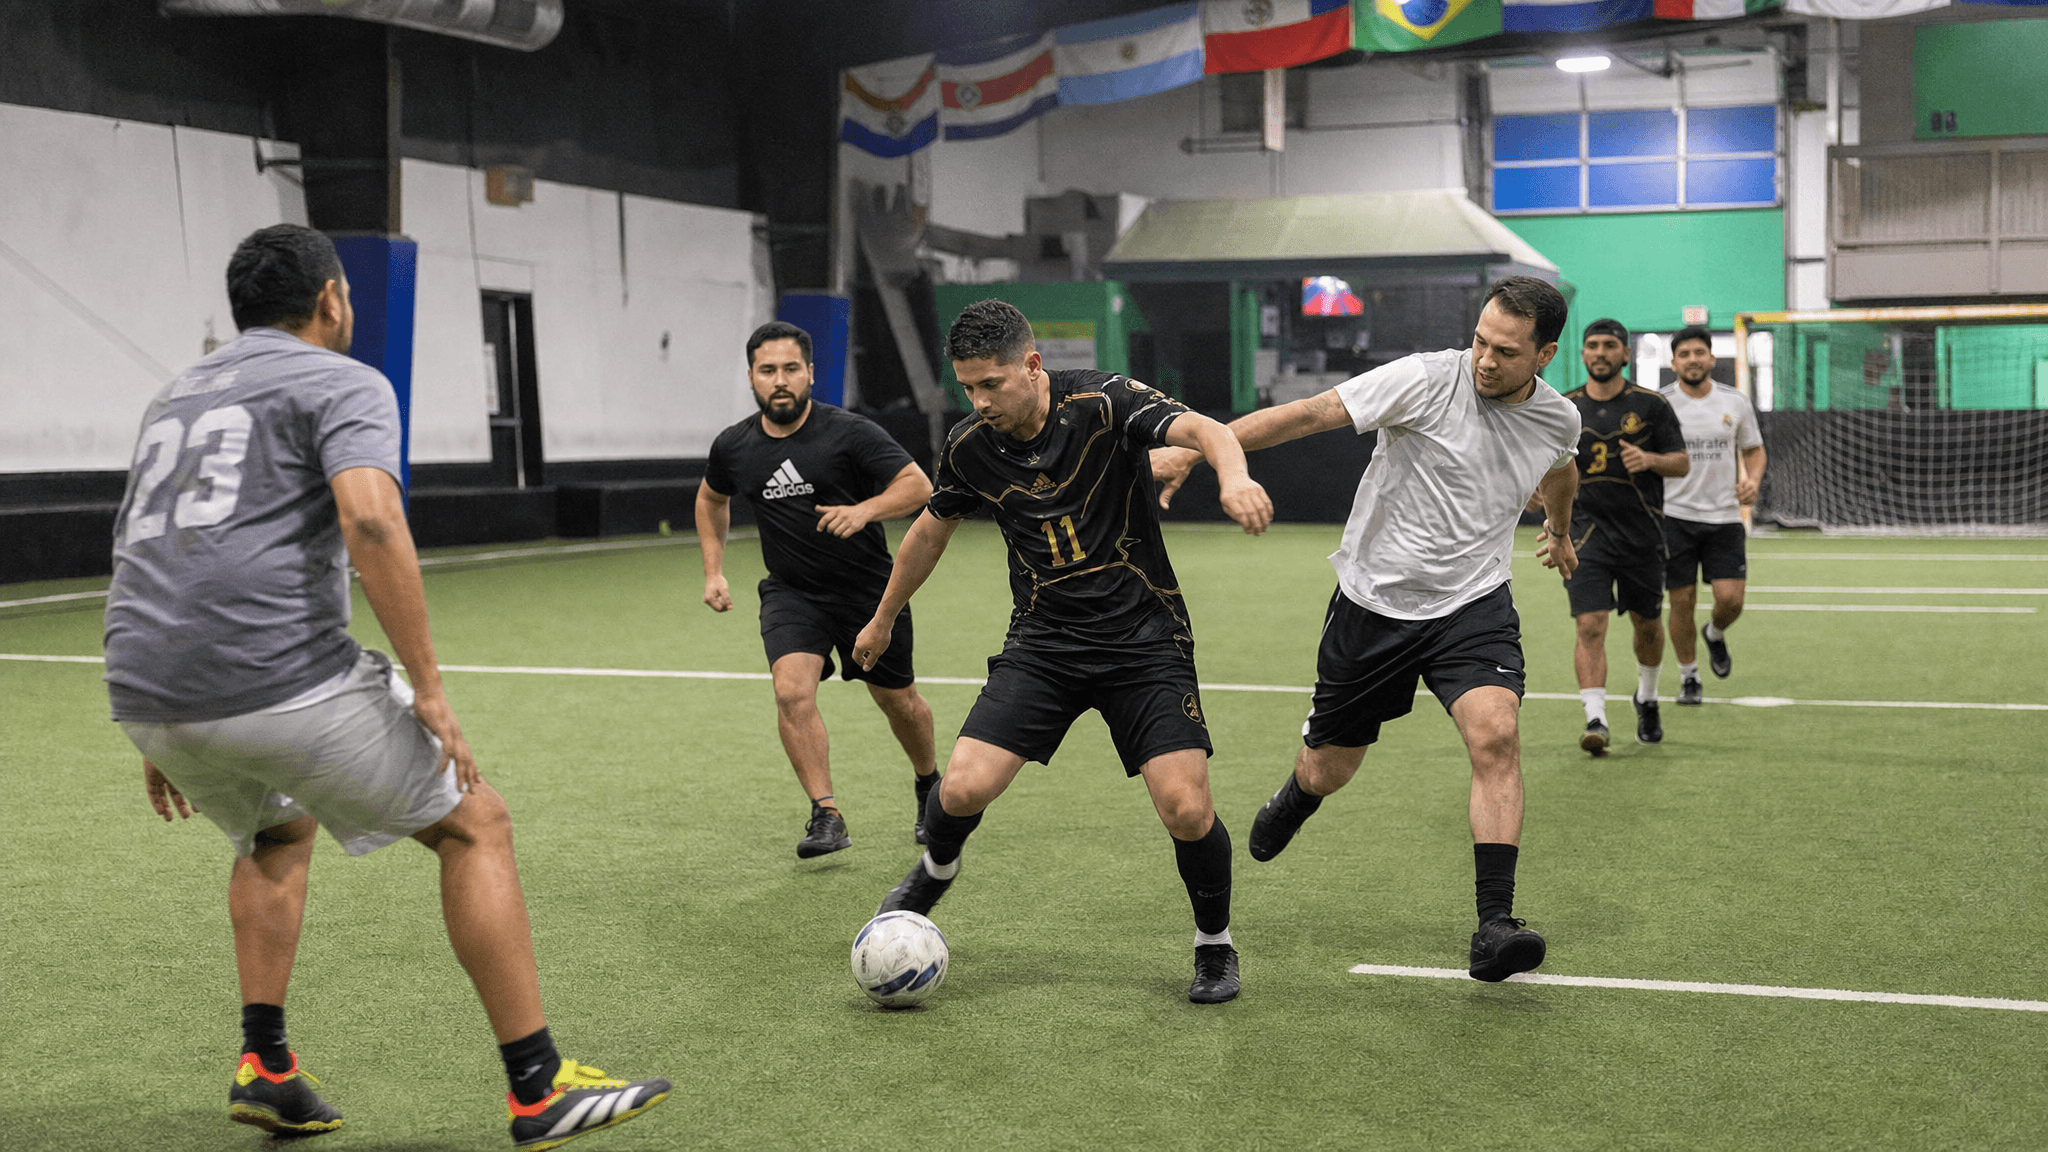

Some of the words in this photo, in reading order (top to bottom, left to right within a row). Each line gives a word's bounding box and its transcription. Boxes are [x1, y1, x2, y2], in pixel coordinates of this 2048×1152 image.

[125, 404, 254, 546] 23
[1586, 441, 1608, 474] 3
[762, 483, 815, 500] adidas
[1041, 515, 1087, 567] 11
